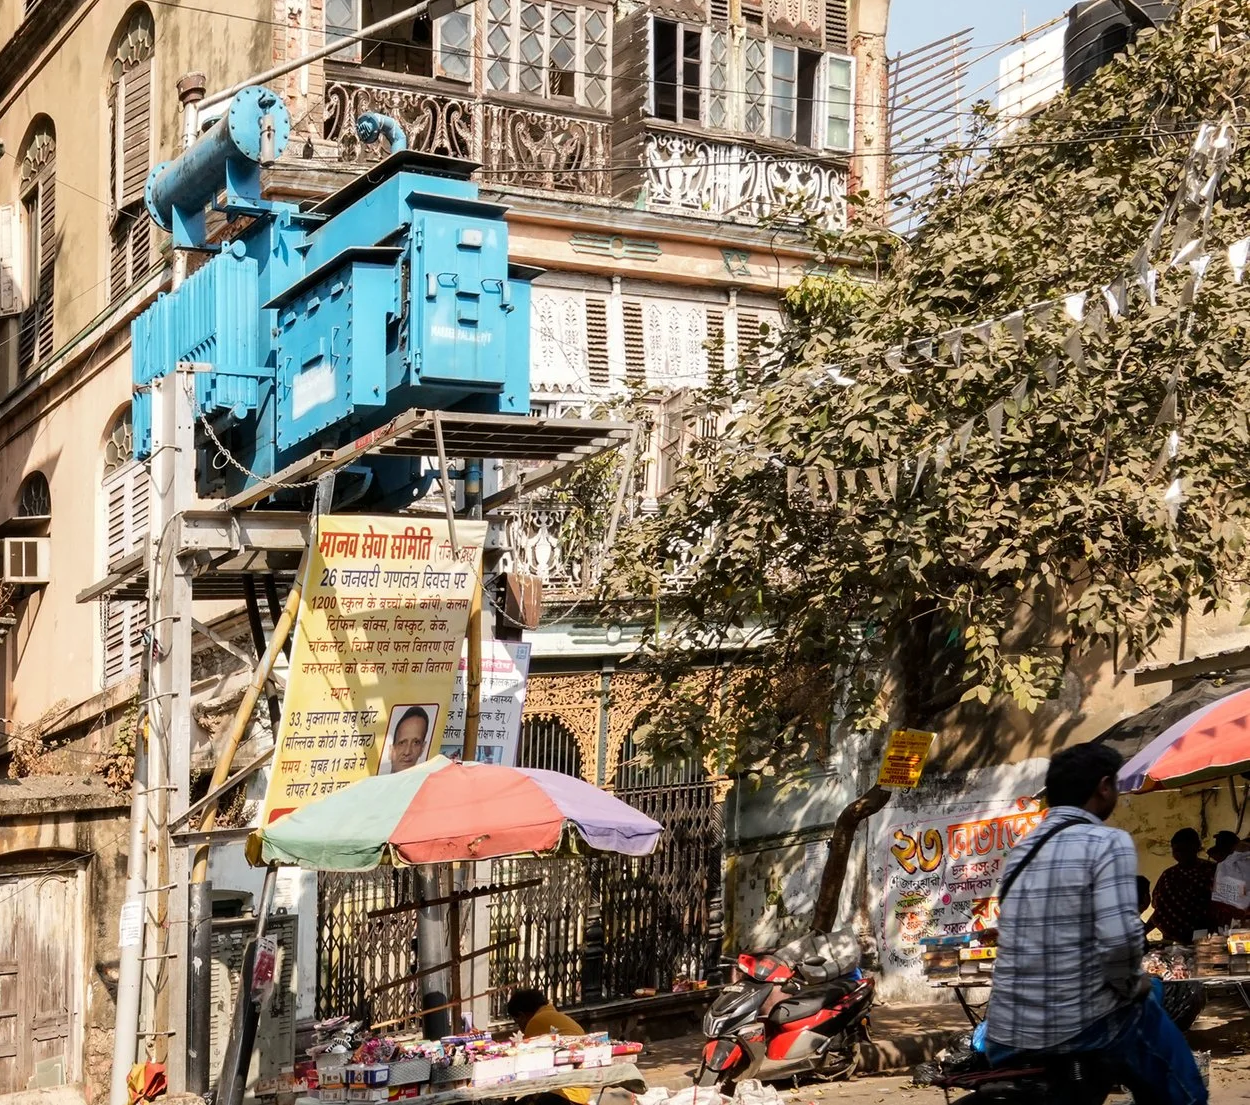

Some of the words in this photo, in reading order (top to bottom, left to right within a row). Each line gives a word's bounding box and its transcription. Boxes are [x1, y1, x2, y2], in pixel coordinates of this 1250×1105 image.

[319, 531, 359, 558] मानव
[362, 525, 388, 559] सेवा
[391, 526, 433, 561] समिति
[320, 568, 337, 587] 26
[341, 564, 381, 588] जनवरी
[383, 565, 420, 589] गणतंत्र
[422, 565, 452, 589] दिवस
[453, 572, 468, 589] पर
[312, 596, 337, 609] 1200
[341, 597, 364, 614] स्कूल
[367, 593, 377, 609] के
[379, 593, 402, 609] बच्चों
[405, 593, 417, 610] को
[420, 595, 443, 611] कॉपी,
[446, 598, 469, 610] कलम
[326, 615, 358, 633] टिफिन,
[362, 616, 390, 633] बॉक्स,
[393, 615, 426, 635] बिस्कुट,
[429, 615, 449, 633] केक,
[308, 636, 347, 655] चॉकलेट,
[350, 637, 375, 653] चिप्स
[376, 637, 391, 656] एवं
[393, 641, 409, 653] फल
[412, 637, 441, 653] वितरण
[442, 637, 456, 656] एवं
[345, 658, 357, 674] को
[360, 658, 387, 675] कंबल,
[392, 658, 409, 674] गंजी
[411, 662, 424, 674] का
[425, 658, 453, 673] वितरण
[331, 687, 350, 702] स्थान
[289, 712, 302, 728] 33,
[306, 711, 340, 730] मुक्ताराम
[343, 711, 358, 729] बाबु
[360, 705, 379, 728] स्ट्रीट
[281, 732, 316, 752] (मल्लिक
[317, 730, 338, 749] कोठी
[339, 730, 349, 747] के
[350, 730, 376, 749] निकट)
[281, 760, 301, 774] समय
[310, 759, 329, 777] सुबह
[331, 758, 342, 769] 11
[343, 752, 357, 770] बजे
[359, 752, 367, 769] से
[286, 779, 311, 798] दोपहर
[312, 782, 318, 796] 2
[320, 777, 334, 795] बजे
[891, 829, 944, 874] ২৩
